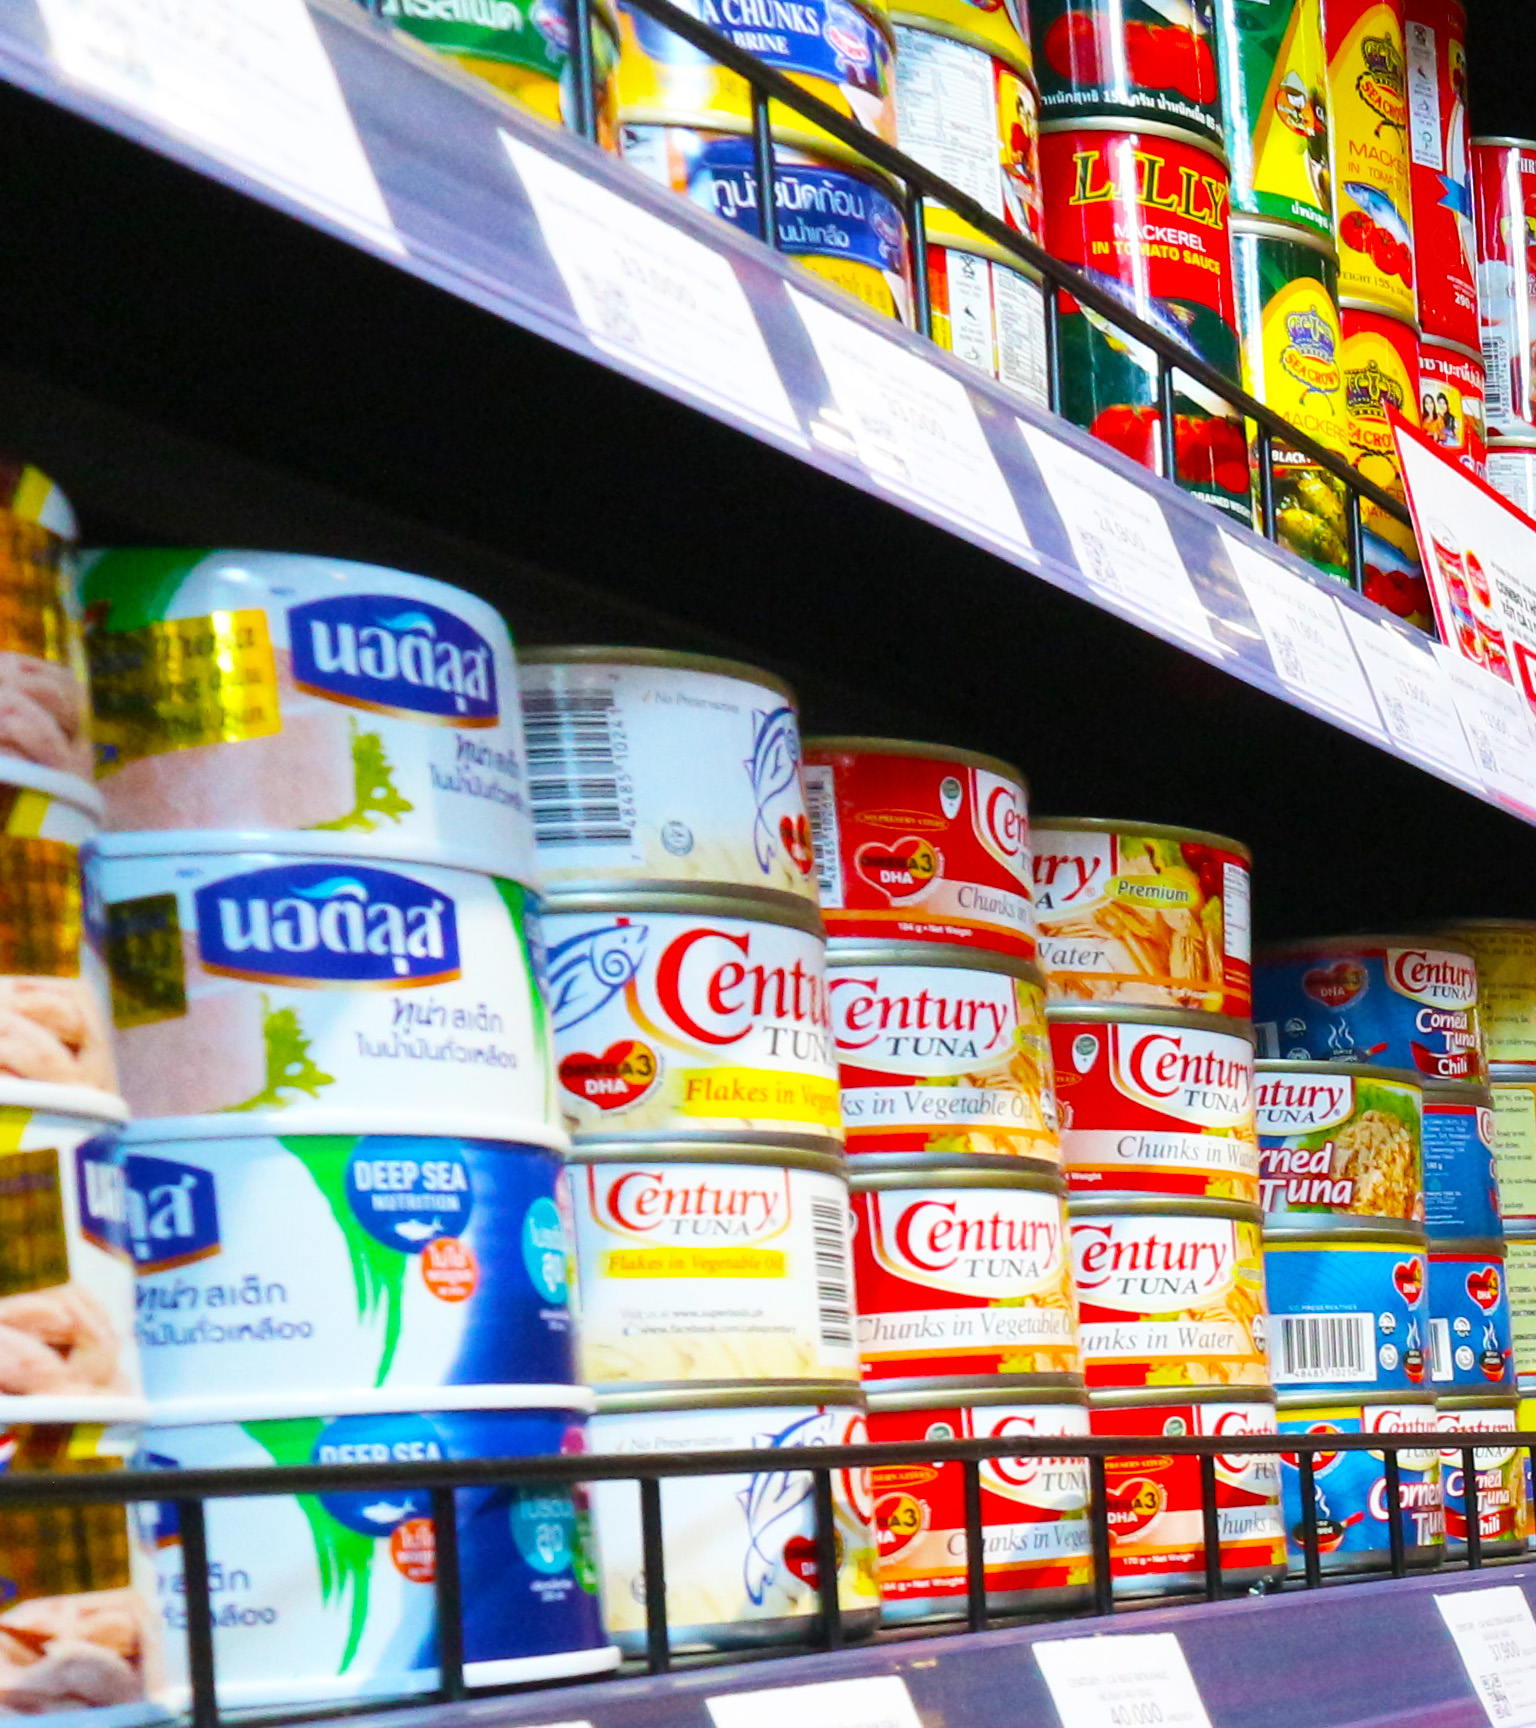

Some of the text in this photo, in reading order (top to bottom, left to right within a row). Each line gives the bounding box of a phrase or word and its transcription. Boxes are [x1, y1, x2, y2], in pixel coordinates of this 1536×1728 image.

[1069, 150, 1229, 230] LILLY
[1092, 241, 1109, 254] IN
[1183, 250, 1220, 275] SAUCE
[880, 870, 914, 886] DHA
[1115, 879, 1191, 904] Premium
[1393, 951, 1476, 998] Century
[1429, 984, 1471, 1001] TUNA
[1416, 1007, 1469, 1037] Corned
[887, 1035, 979, 1060] TUNA
[1442, 1028, 1476, 1050] Tuna
[1128, 1032, 1253, 1099] Century
[1436, 1053, 1468, 1076] Chili
[585, 1077, 628, 1096] DHA
[685, 1077, 797, 1105] Flakes in
[873, 1087, 1007, 1116] in Vegetable
[1184, 1088, 1242, 1114] TUNA
[1116, 1135, 1224, 1164] Chunks in
[354, 1158, 467, 1194] DEEP SEA
[372, 1192, 460, 1213] NUTRITION
[604, 1170, 779, 1238] Century
[669, 1218, 751, 1237] TUNA
[895, 1201, 1058, 1275] Century
[608, 1256, 658, 1274] Flakes
[669, 1255, 687, 1272] in
[691, 1254, 758, 1274] Vegetable
[964, 1257, 1040, 1280] TUNA
[1070, 1222, 1227, 1291] Century
[1116, 1276, 1199, 1297] TUNA
[858, 1310, 1062, 1342] Chunks in Vegetable
[1080, 1326, 1234, 1353] unks in Water
